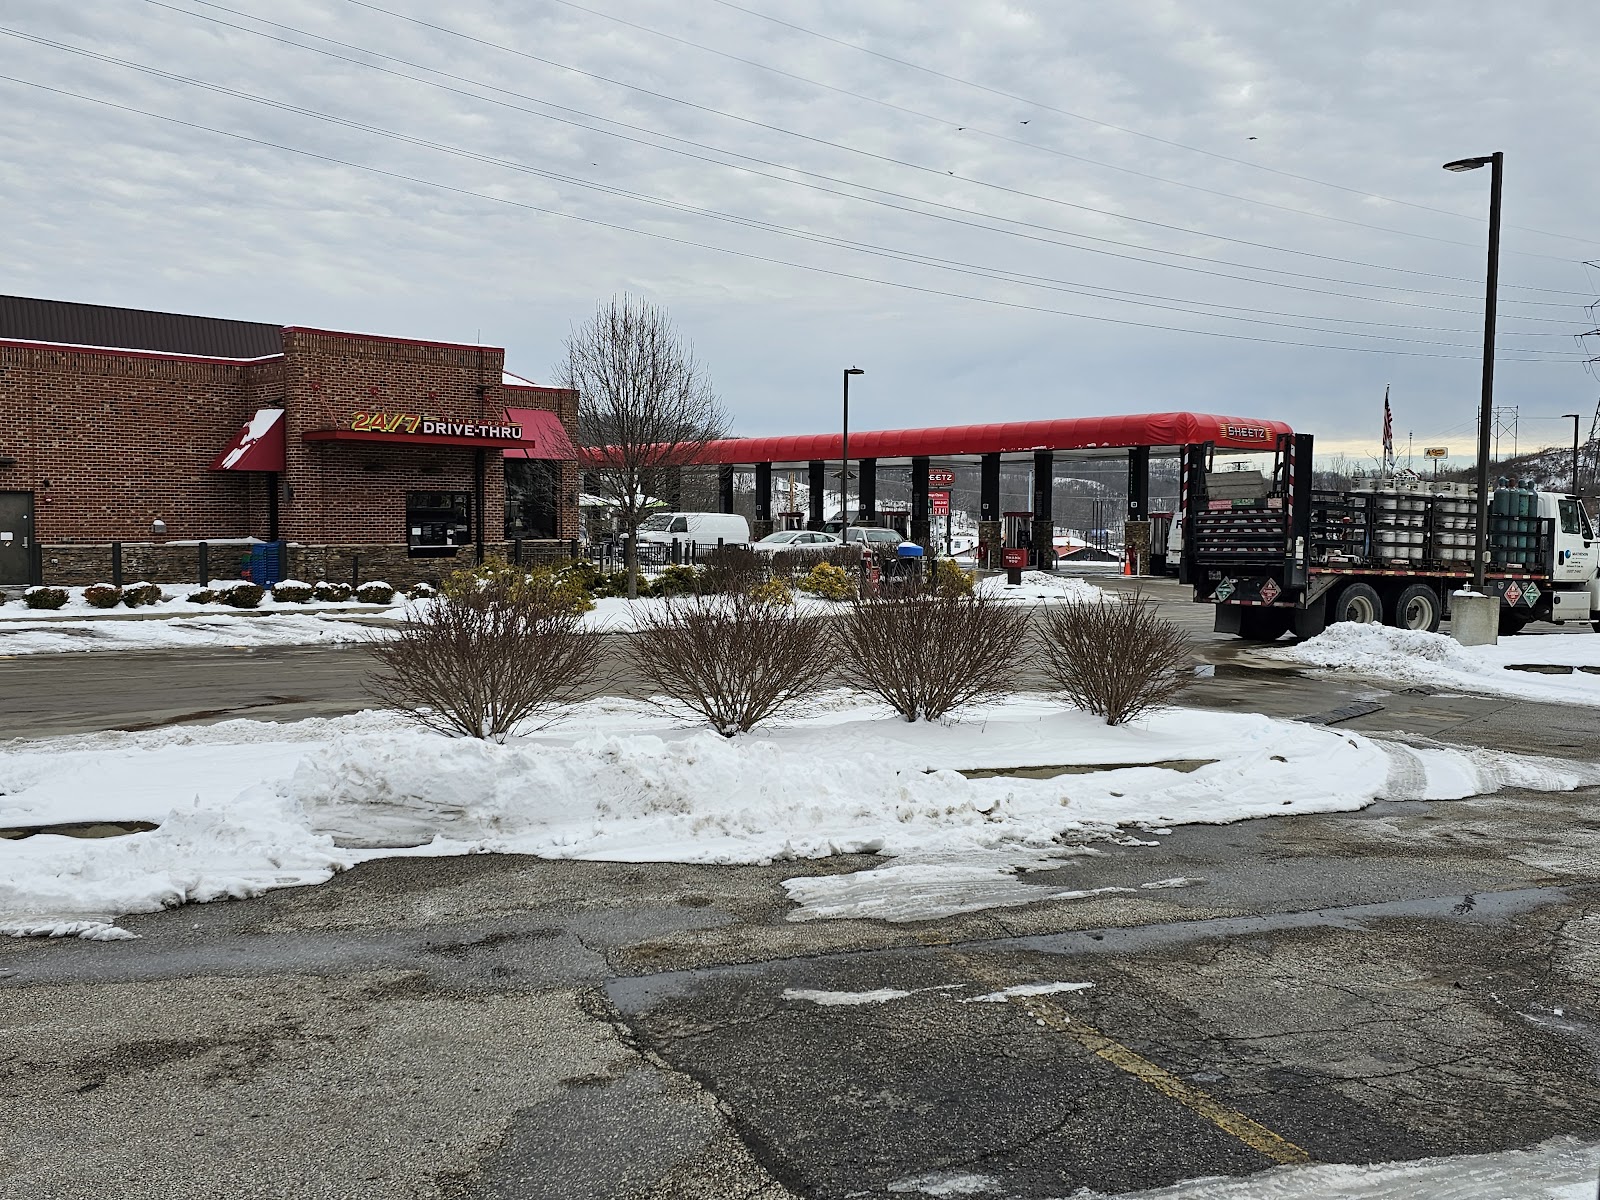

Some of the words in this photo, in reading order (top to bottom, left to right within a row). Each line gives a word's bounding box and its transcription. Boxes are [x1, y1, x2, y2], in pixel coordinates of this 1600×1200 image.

[352, 411, 421, 434] 24/7
[423, 422, 523, 439] DRIVE-THRU
[1228, 426, 1265, 438] SHEETZ
